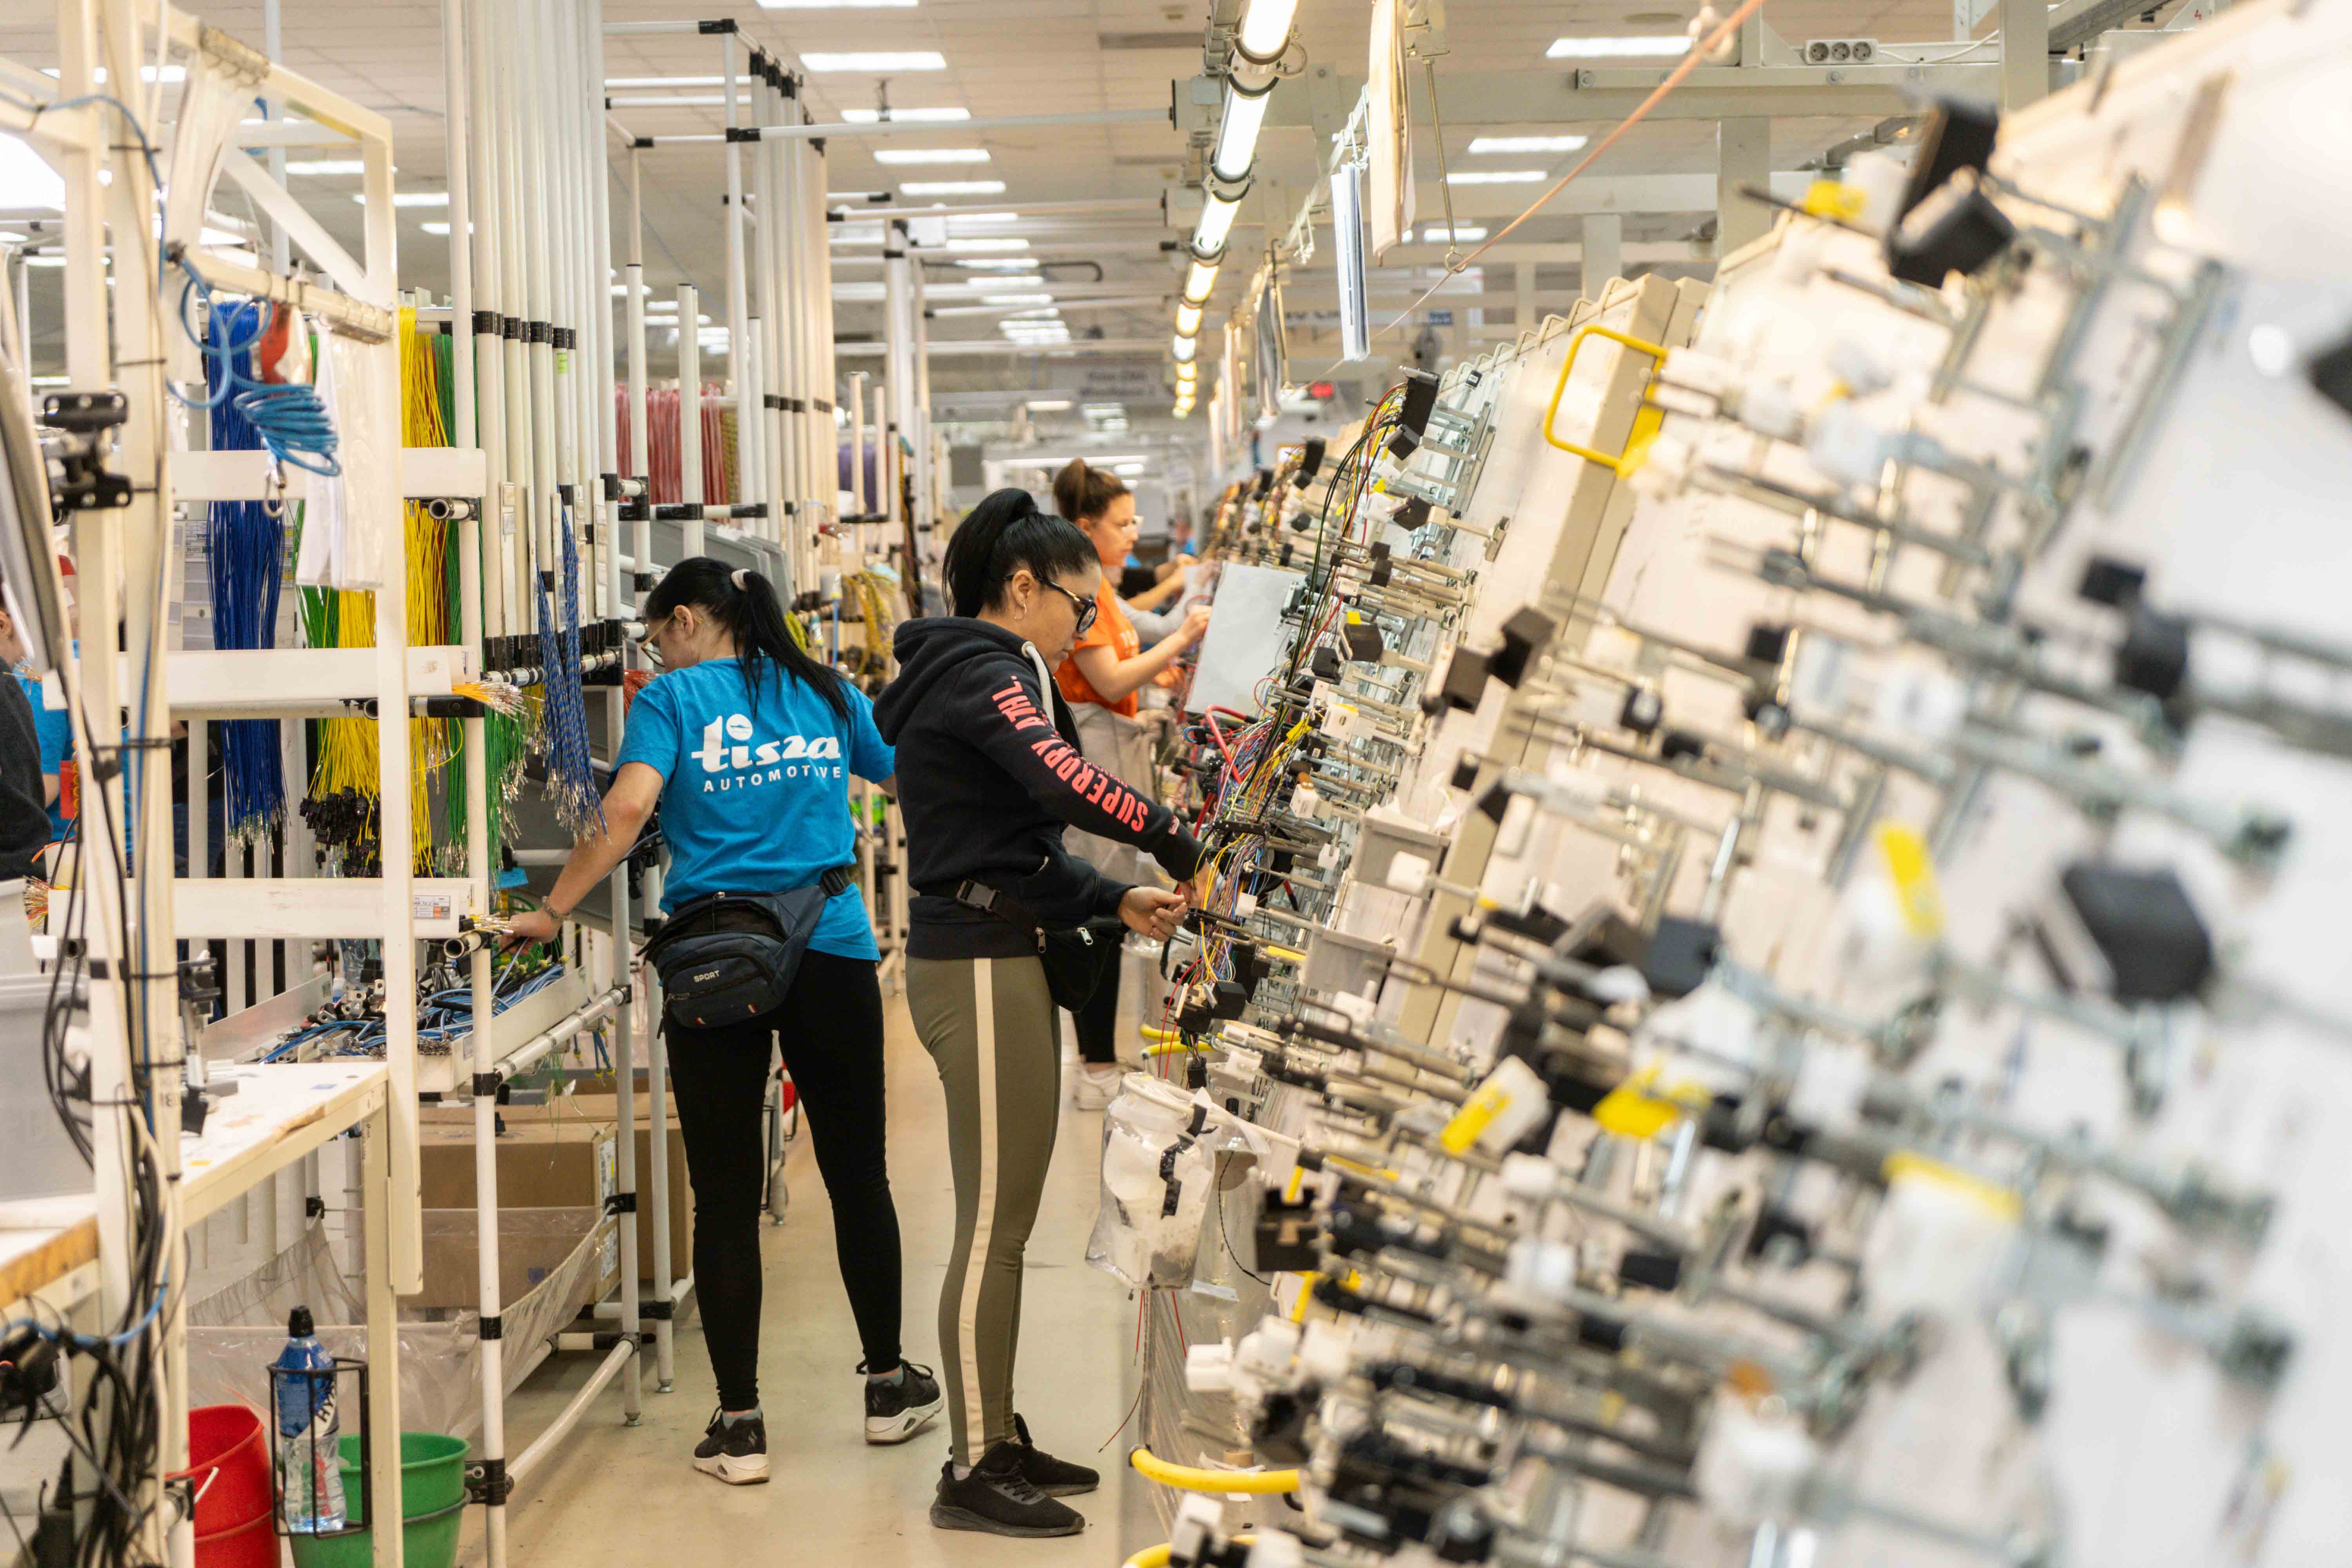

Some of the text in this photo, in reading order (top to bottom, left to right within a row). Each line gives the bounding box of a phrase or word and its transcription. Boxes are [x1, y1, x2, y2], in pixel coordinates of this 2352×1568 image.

[691, 713, 841, 773] tisza
[703, 765, 841, 792] AUTOMOTIVE
[693, 970, 719, 982] SPORT
